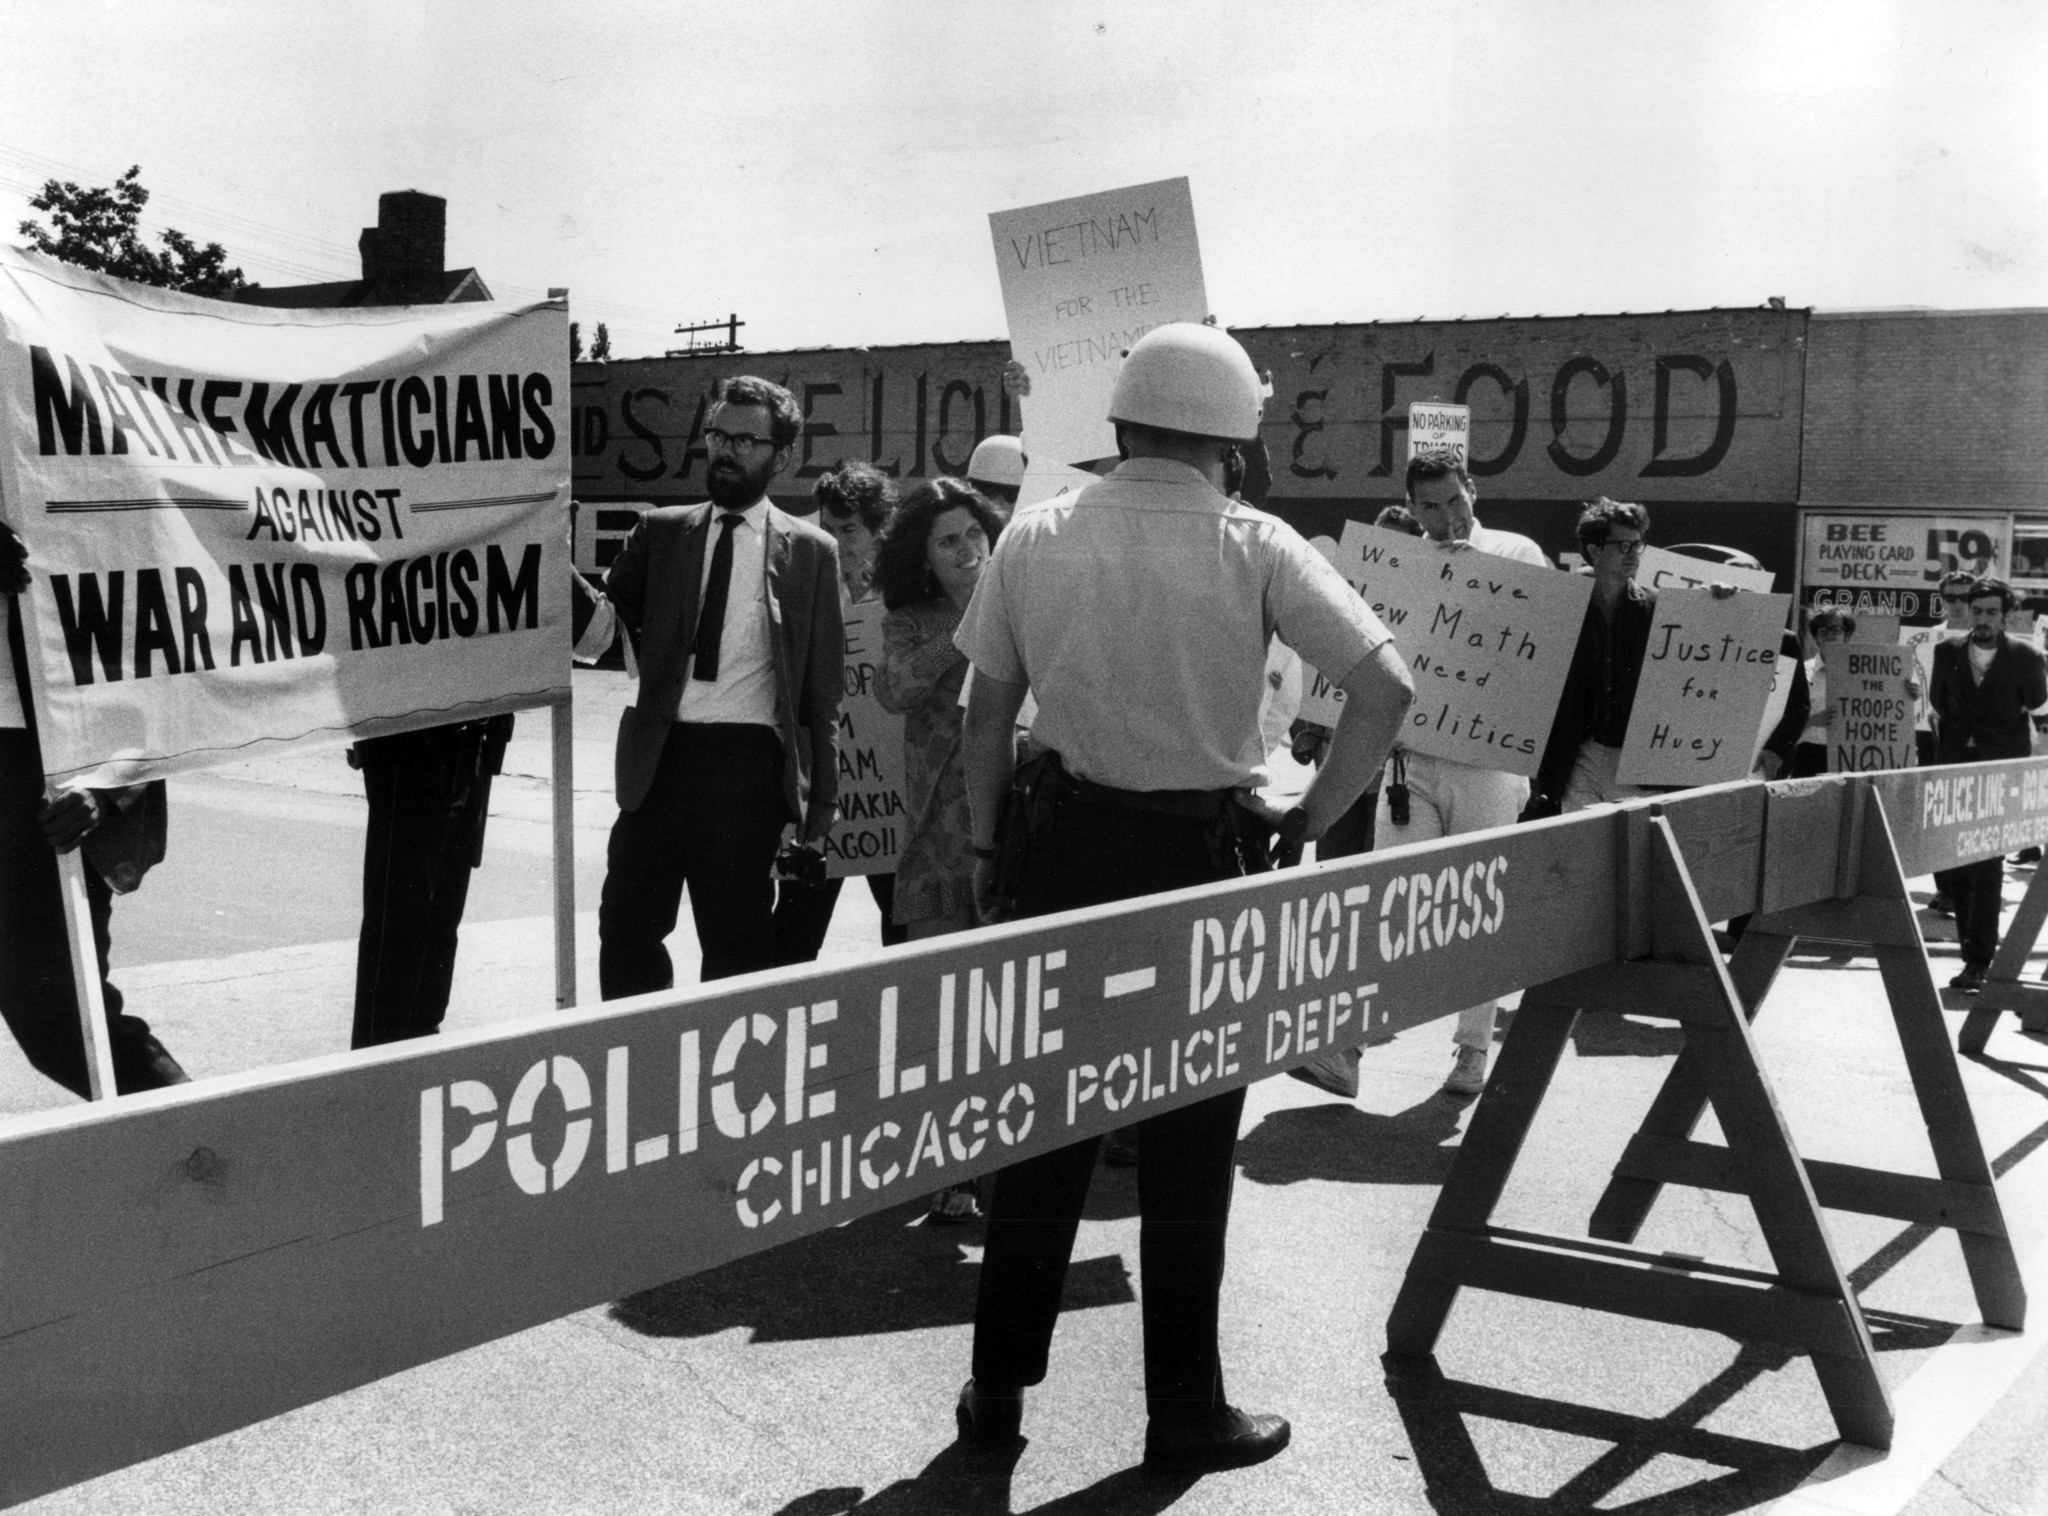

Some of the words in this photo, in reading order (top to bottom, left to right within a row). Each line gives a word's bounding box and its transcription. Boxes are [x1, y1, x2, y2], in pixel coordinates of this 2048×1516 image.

[1010, 206, 1160, 270] VIETNAM
[1054, 295, 1094, 320] FOR
[1108, 283, 1160, 308] THE
[30, 344, 557, 468] MATHEMATICIANS
[1366, 350, 1738, 478] FOOD
[1412, 412, 1427, 430] NO
[1427, 411, 1467, 432] PARKING
[246, 486, 405, 542] AGAINST
[1826, 523, 1888, 542] BEE
[1361, 544, 1400, 568] We
[1440, 562, 1528, 600] have
[1818, 544, 1875, 561] PLAYING
[1879, 545, 1915, 561] CARD
[1840, 562, 1889, 582] DECK
[50, 565, 217, 687] WAR
[230, 562, 327, 668] AND
[344, 543, 543, 652] RACISM
[1813, 588, 1920, 617] GRAND
[1430, 602, 1537, 661] Math
[1651, 624, 1775, 664] Justice
[1413, 653, 1491, 687] Need
[1848, 654, 1902, 676] BRING
[1862, 680, 1884, 692] THE
[1412, 698, 1537, 754] olitics
[1838, 697, 1905, 721] TROOPS
[1650, 723, 1723, 761] Huey
[1845, 720, 1898, 742] HOME
[1922, 776, 1975, 830] POLICE
[1976, 773, 2007, 819] LINE
[1957, 824, 2001, 857] CHICAGO
[2002, 818, 2033, 849] POLICE
[419, 999, 840, 1229] POLICE
[878, 950, 1067, 1099] LINE
[1188, 907, 1267, 1016] DO
[1277, 885, 1371, 991] NOT
[1378, 855, 1509, 963] CROSS
[735, 1082, 1036, 1230] CHICAGO
[1066, 1021, 1242, 1126] POLICE
[1265, 982, 1390, 1065] DEPT.
